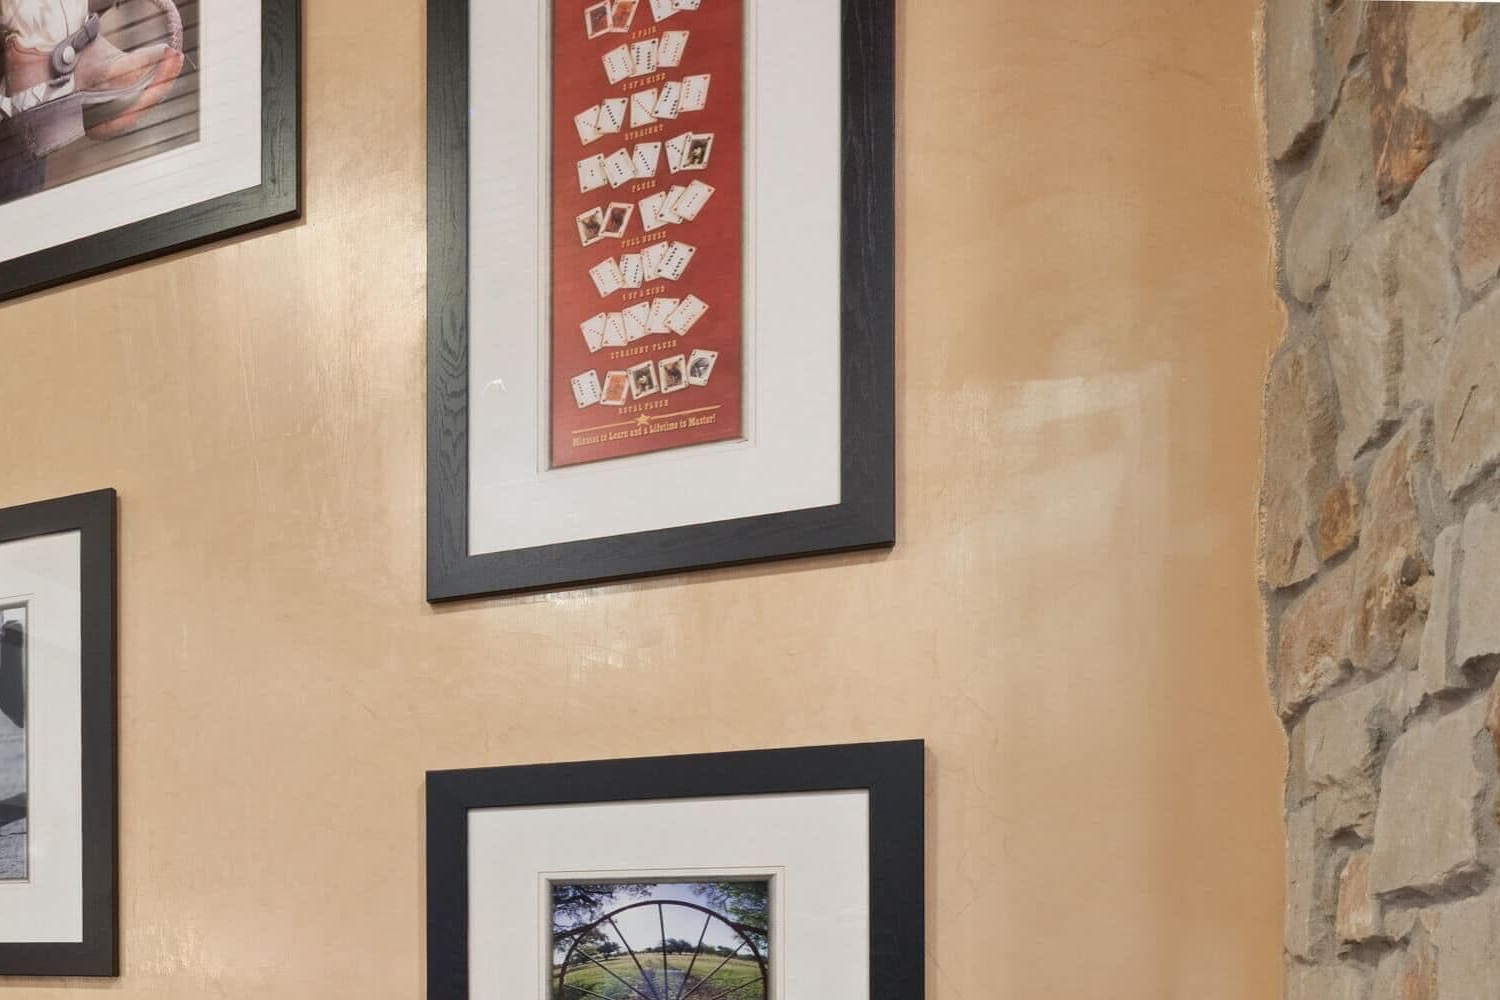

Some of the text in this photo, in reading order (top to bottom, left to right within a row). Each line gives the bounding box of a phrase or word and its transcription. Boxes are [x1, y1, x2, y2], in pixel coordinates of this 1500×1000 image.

[611, 339, 677, 360] STRAIGHT FLUSH
[618, 399, 669, 415] ROYAL FLUSH
[609, 431, 628, 441] Learn
[630, 426, 642, 437] and
[649, 421, 678, 434] Lifetime
[680, 419, 687, 428] to
[687, 412, 716, 427] Master!
